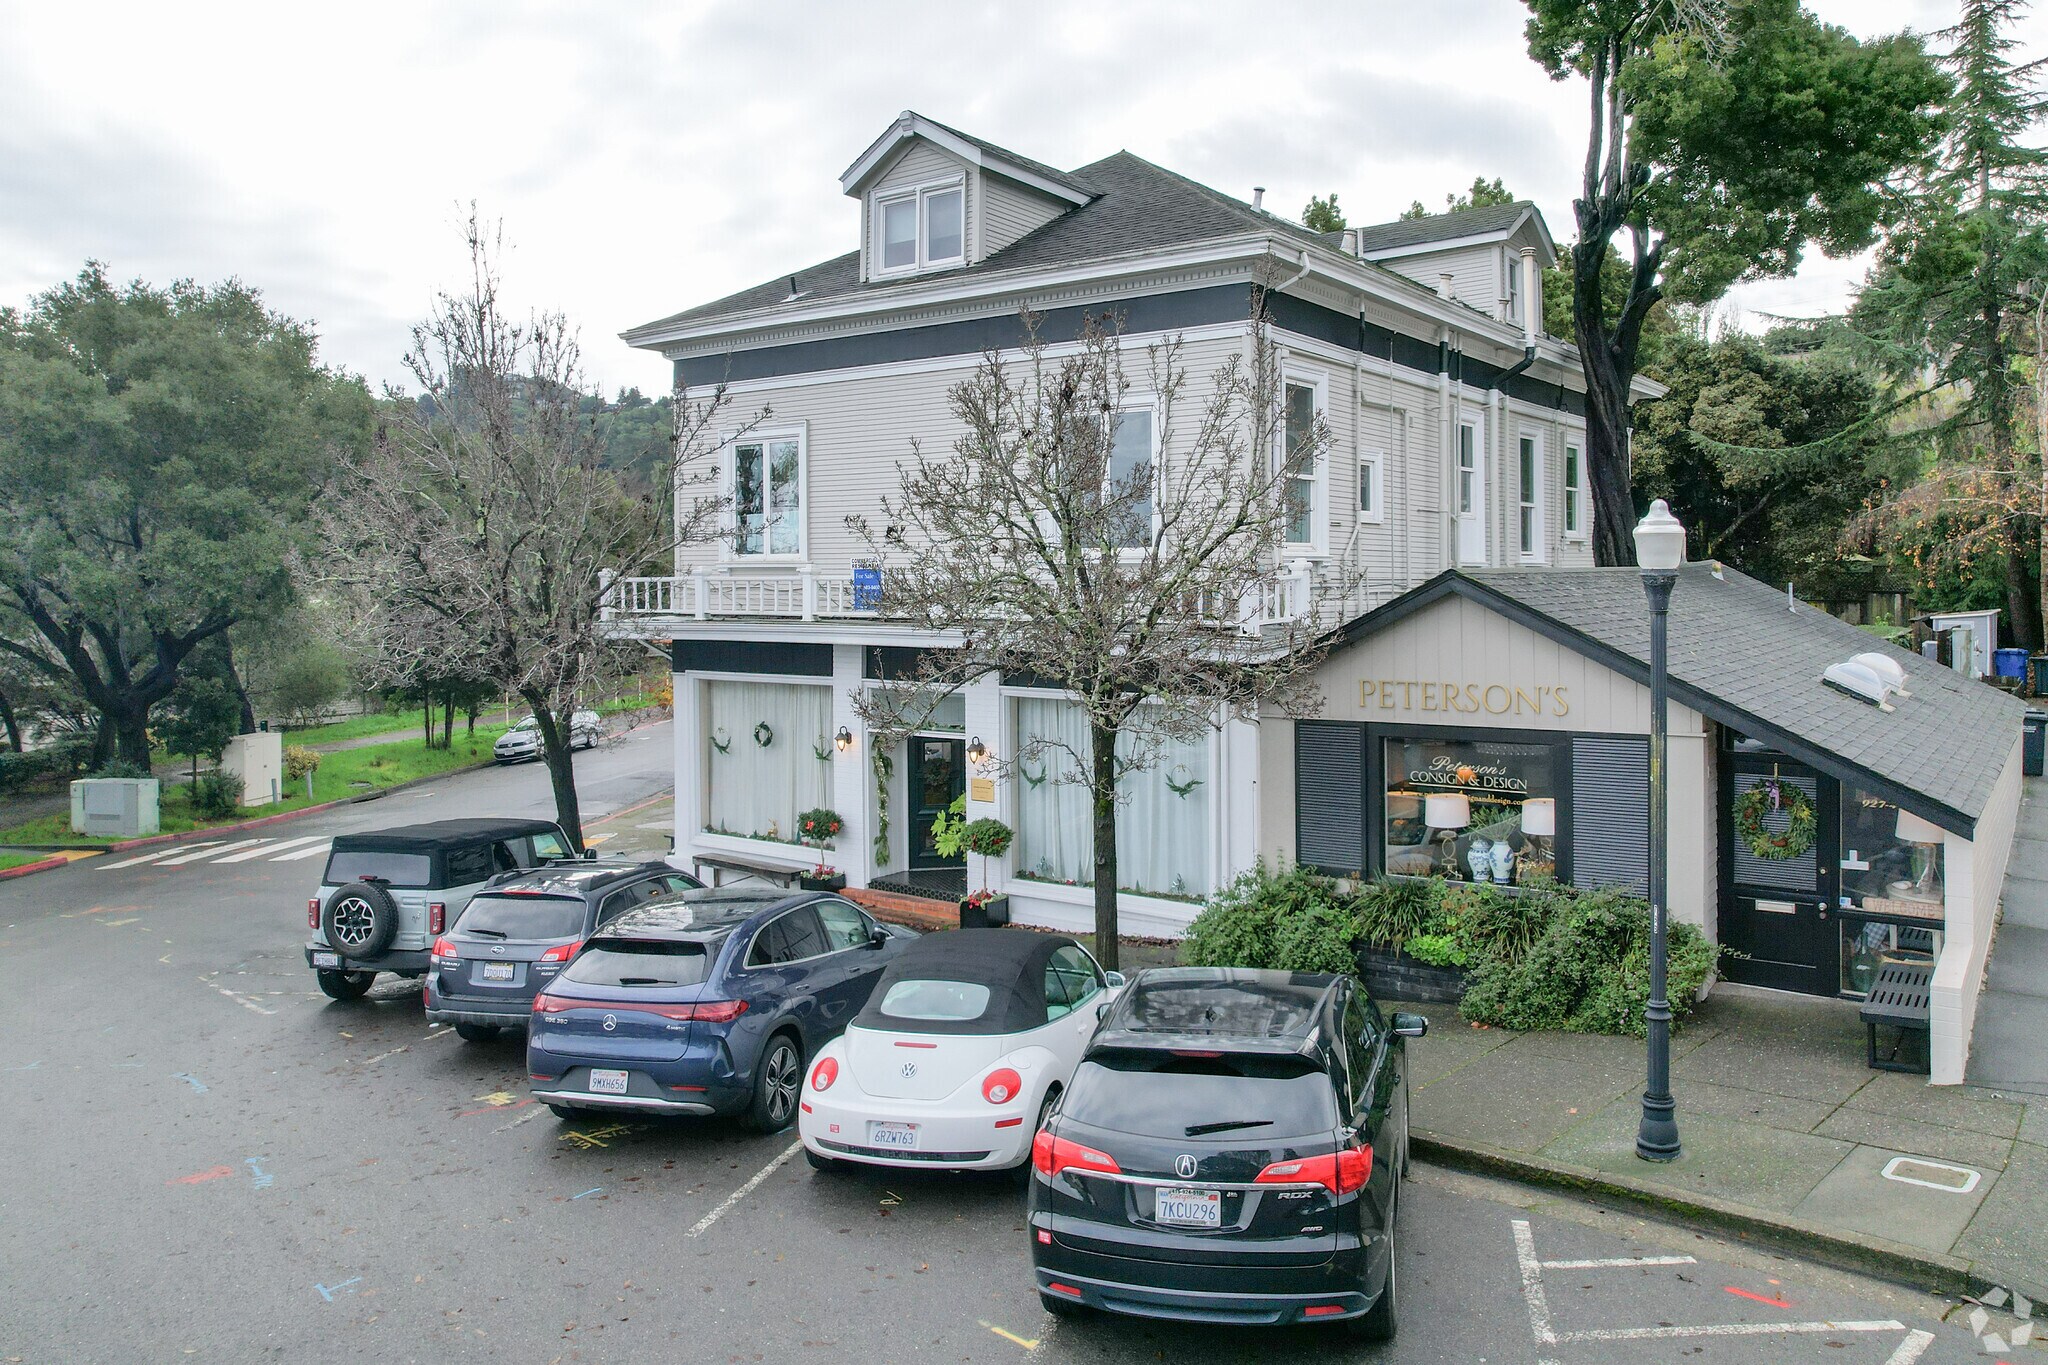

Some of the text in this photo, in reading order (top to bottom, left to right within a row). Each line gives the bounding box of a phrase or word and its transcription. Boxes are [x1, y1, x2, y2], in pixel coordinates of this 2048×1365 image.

[1358, 679, 1569, 717] PETERSON'S
[1428, 755, 1507, 775] Peterson's
[1409, 770, 1528, 790] CONSIGN & DESIGN
[1862, 799, 1887, 808] 927
[592, 1077, 625, 1090] 9MXH656
[874, 1130, 914, 1145] 6RZW763
[1278, 1191, 1314, 1200] RDX
[1161, 1201, 1216, 1220] 7KCU296
